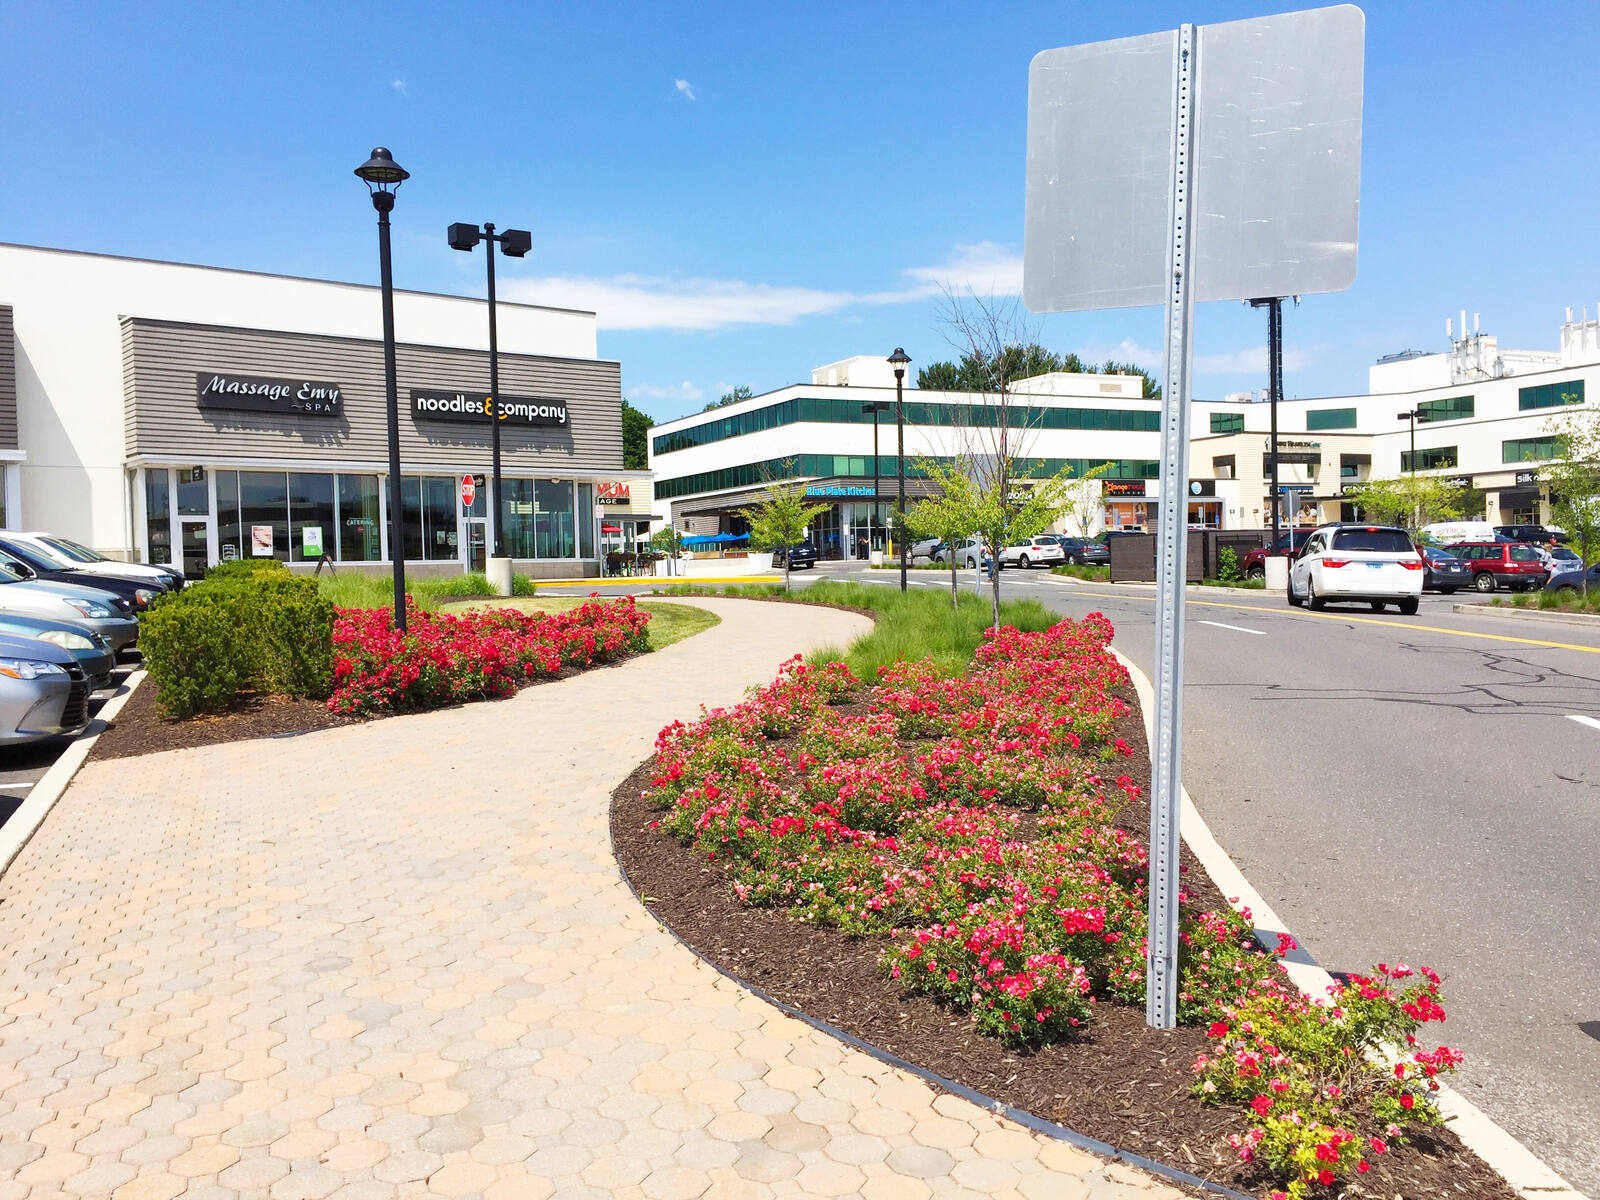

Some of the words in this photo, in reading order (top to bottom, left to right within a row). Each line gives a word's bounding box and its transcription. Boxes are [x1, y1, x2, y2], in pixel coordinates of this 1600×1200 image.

[201, 375, 290, 400] Massage
[296, 382, 339, 404] Envy
[305, 402, 331, 412] SPA
[1517, 473, 1533, 483] silk
[462, 484, 475, 496] STOP
[807, 486, 824, 496] Blue
[826, 486, 845, 496] Plate
[346, 519, 375, 527] CATERING
